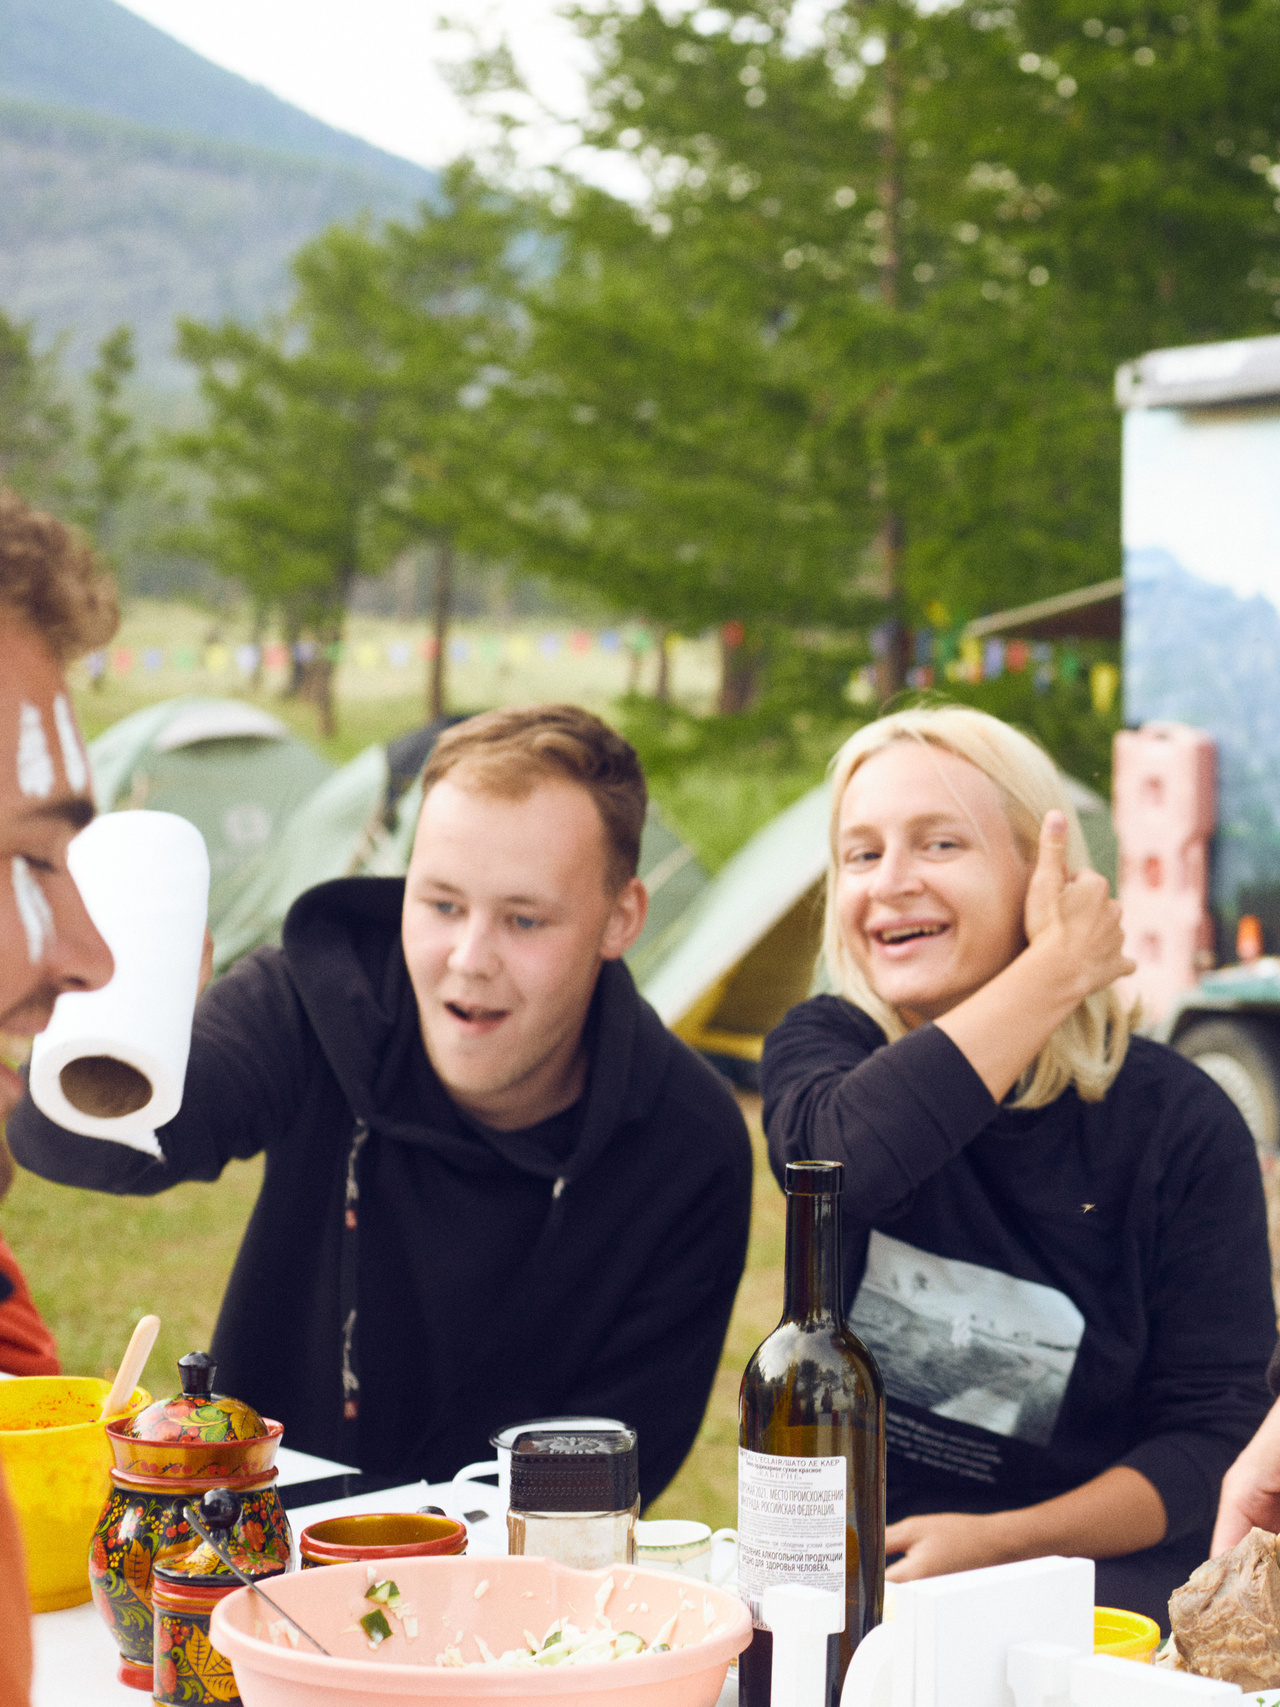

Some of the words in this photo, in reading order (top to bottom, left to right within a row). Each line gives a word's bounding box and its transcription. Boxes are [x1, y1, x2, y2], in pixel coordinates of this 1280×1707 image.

[821, 1459, 840, 1467] КЛЕР
[770, 1489, 789, 1501] МЕСТО
[789, 1489, 844, 1503] ПРОИСХОЖДЕНИЯ
[761, 1500, 796, 1514] РОССИЙСКАЯ
[797, 1503, 836, 1517] ФЕДЕРАЦИЯ.
[761, 1551, 803, 1563] АЛКОГОЛЬНОЙ
[804, 1552, 843, 1564] ПРОДУКЦИИ
[754, 1558, 764, 1568] ДЛЯ
[765, 1561, 796, 1571] ЗДОРОВЬЯ
[796, 1563, 831, 1572] ЧЕЛОВЕКА.
